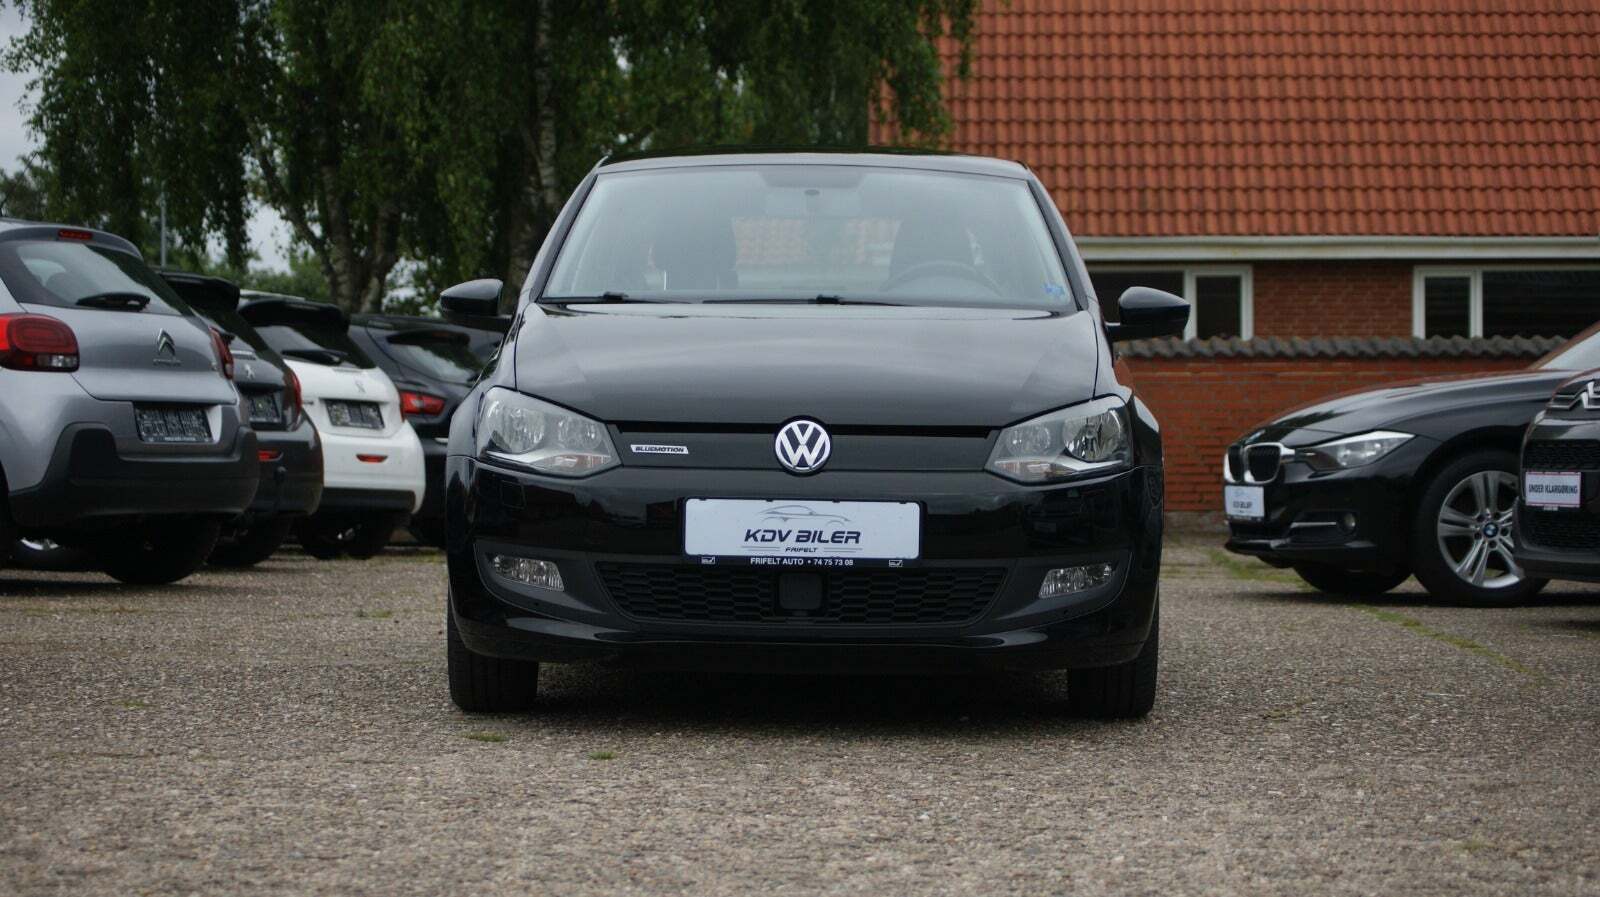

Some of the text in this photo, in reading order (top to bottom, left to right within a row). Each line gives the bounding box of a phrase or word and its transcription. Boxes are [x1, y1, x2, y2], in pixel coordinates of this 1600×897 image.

[777, 421, 828, 470] VW
[744, 529, 861, 544] KDV BILER
[750, 557, 780, 565] FRIFELT
[813, 558, 822, 566] 74
[824, 558, 833, 566] 75
